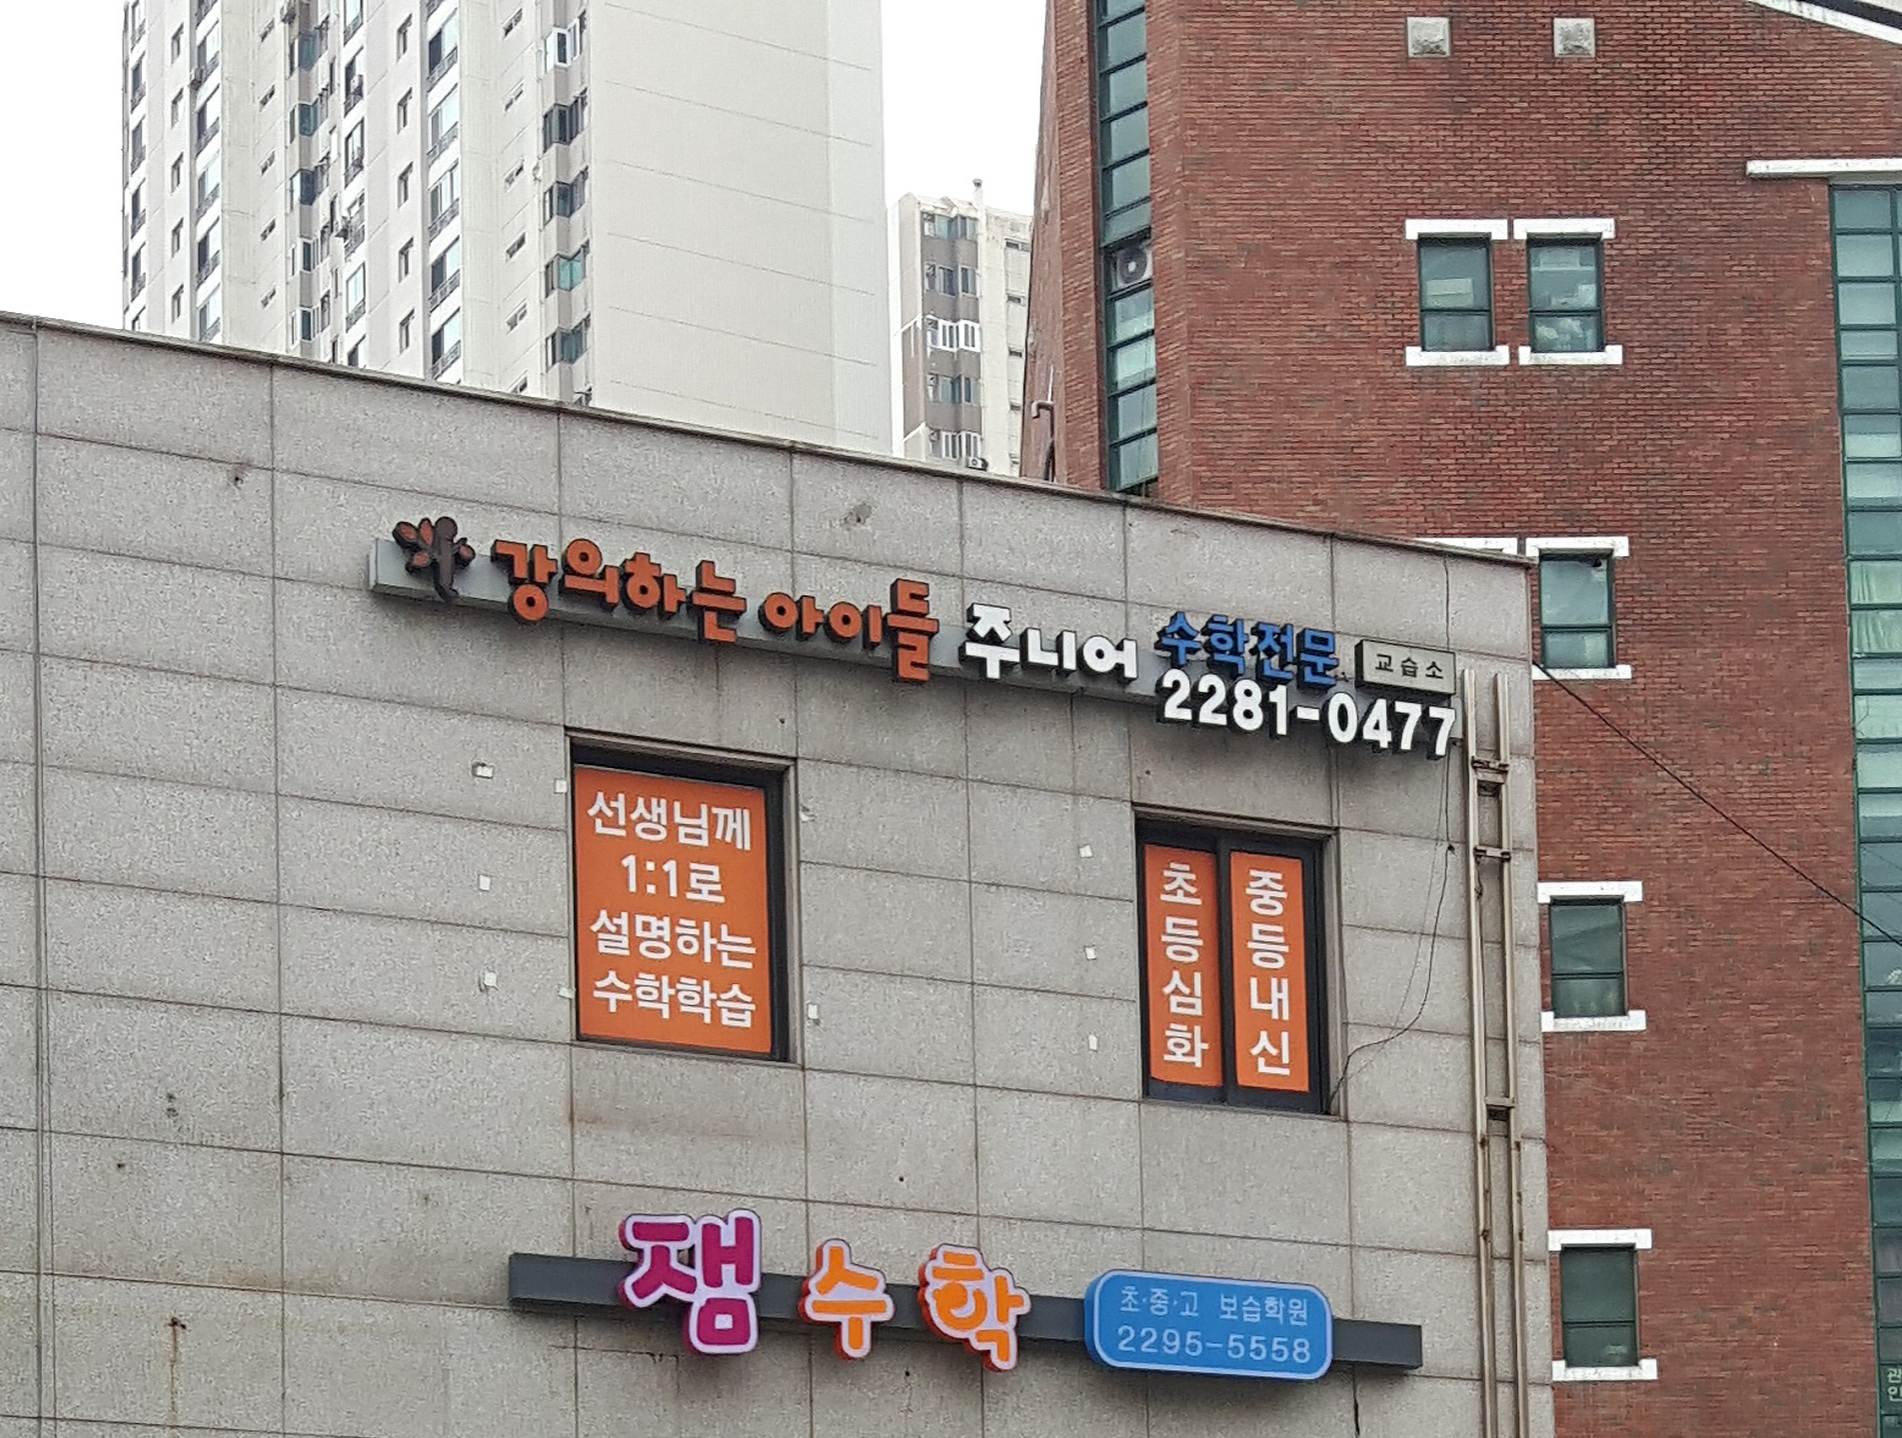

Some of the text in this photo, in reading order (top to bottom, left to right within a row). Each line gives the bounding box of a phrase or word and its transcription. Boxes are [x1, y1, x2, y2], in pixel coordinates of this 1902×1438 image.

[491, 533, 1139, 682] 강의하는 아이들 주니어
[1158, 610, 1339, 687] 수학전문
[1374, 652, 1445, 681] 교습소
[1158, 668, 1457, 759] 2281-0477
[586, 791, 752, 851] 선생님께
[621, 854, 726, 904] 1:1로
[589, 909, 757, 970] 설명하는
[592, 970, 757, 1028] 수학학습
[1218, 1293, 1309, 1327] 보습학원
[1116, 1324, 1312, 1365] 2295-5558
